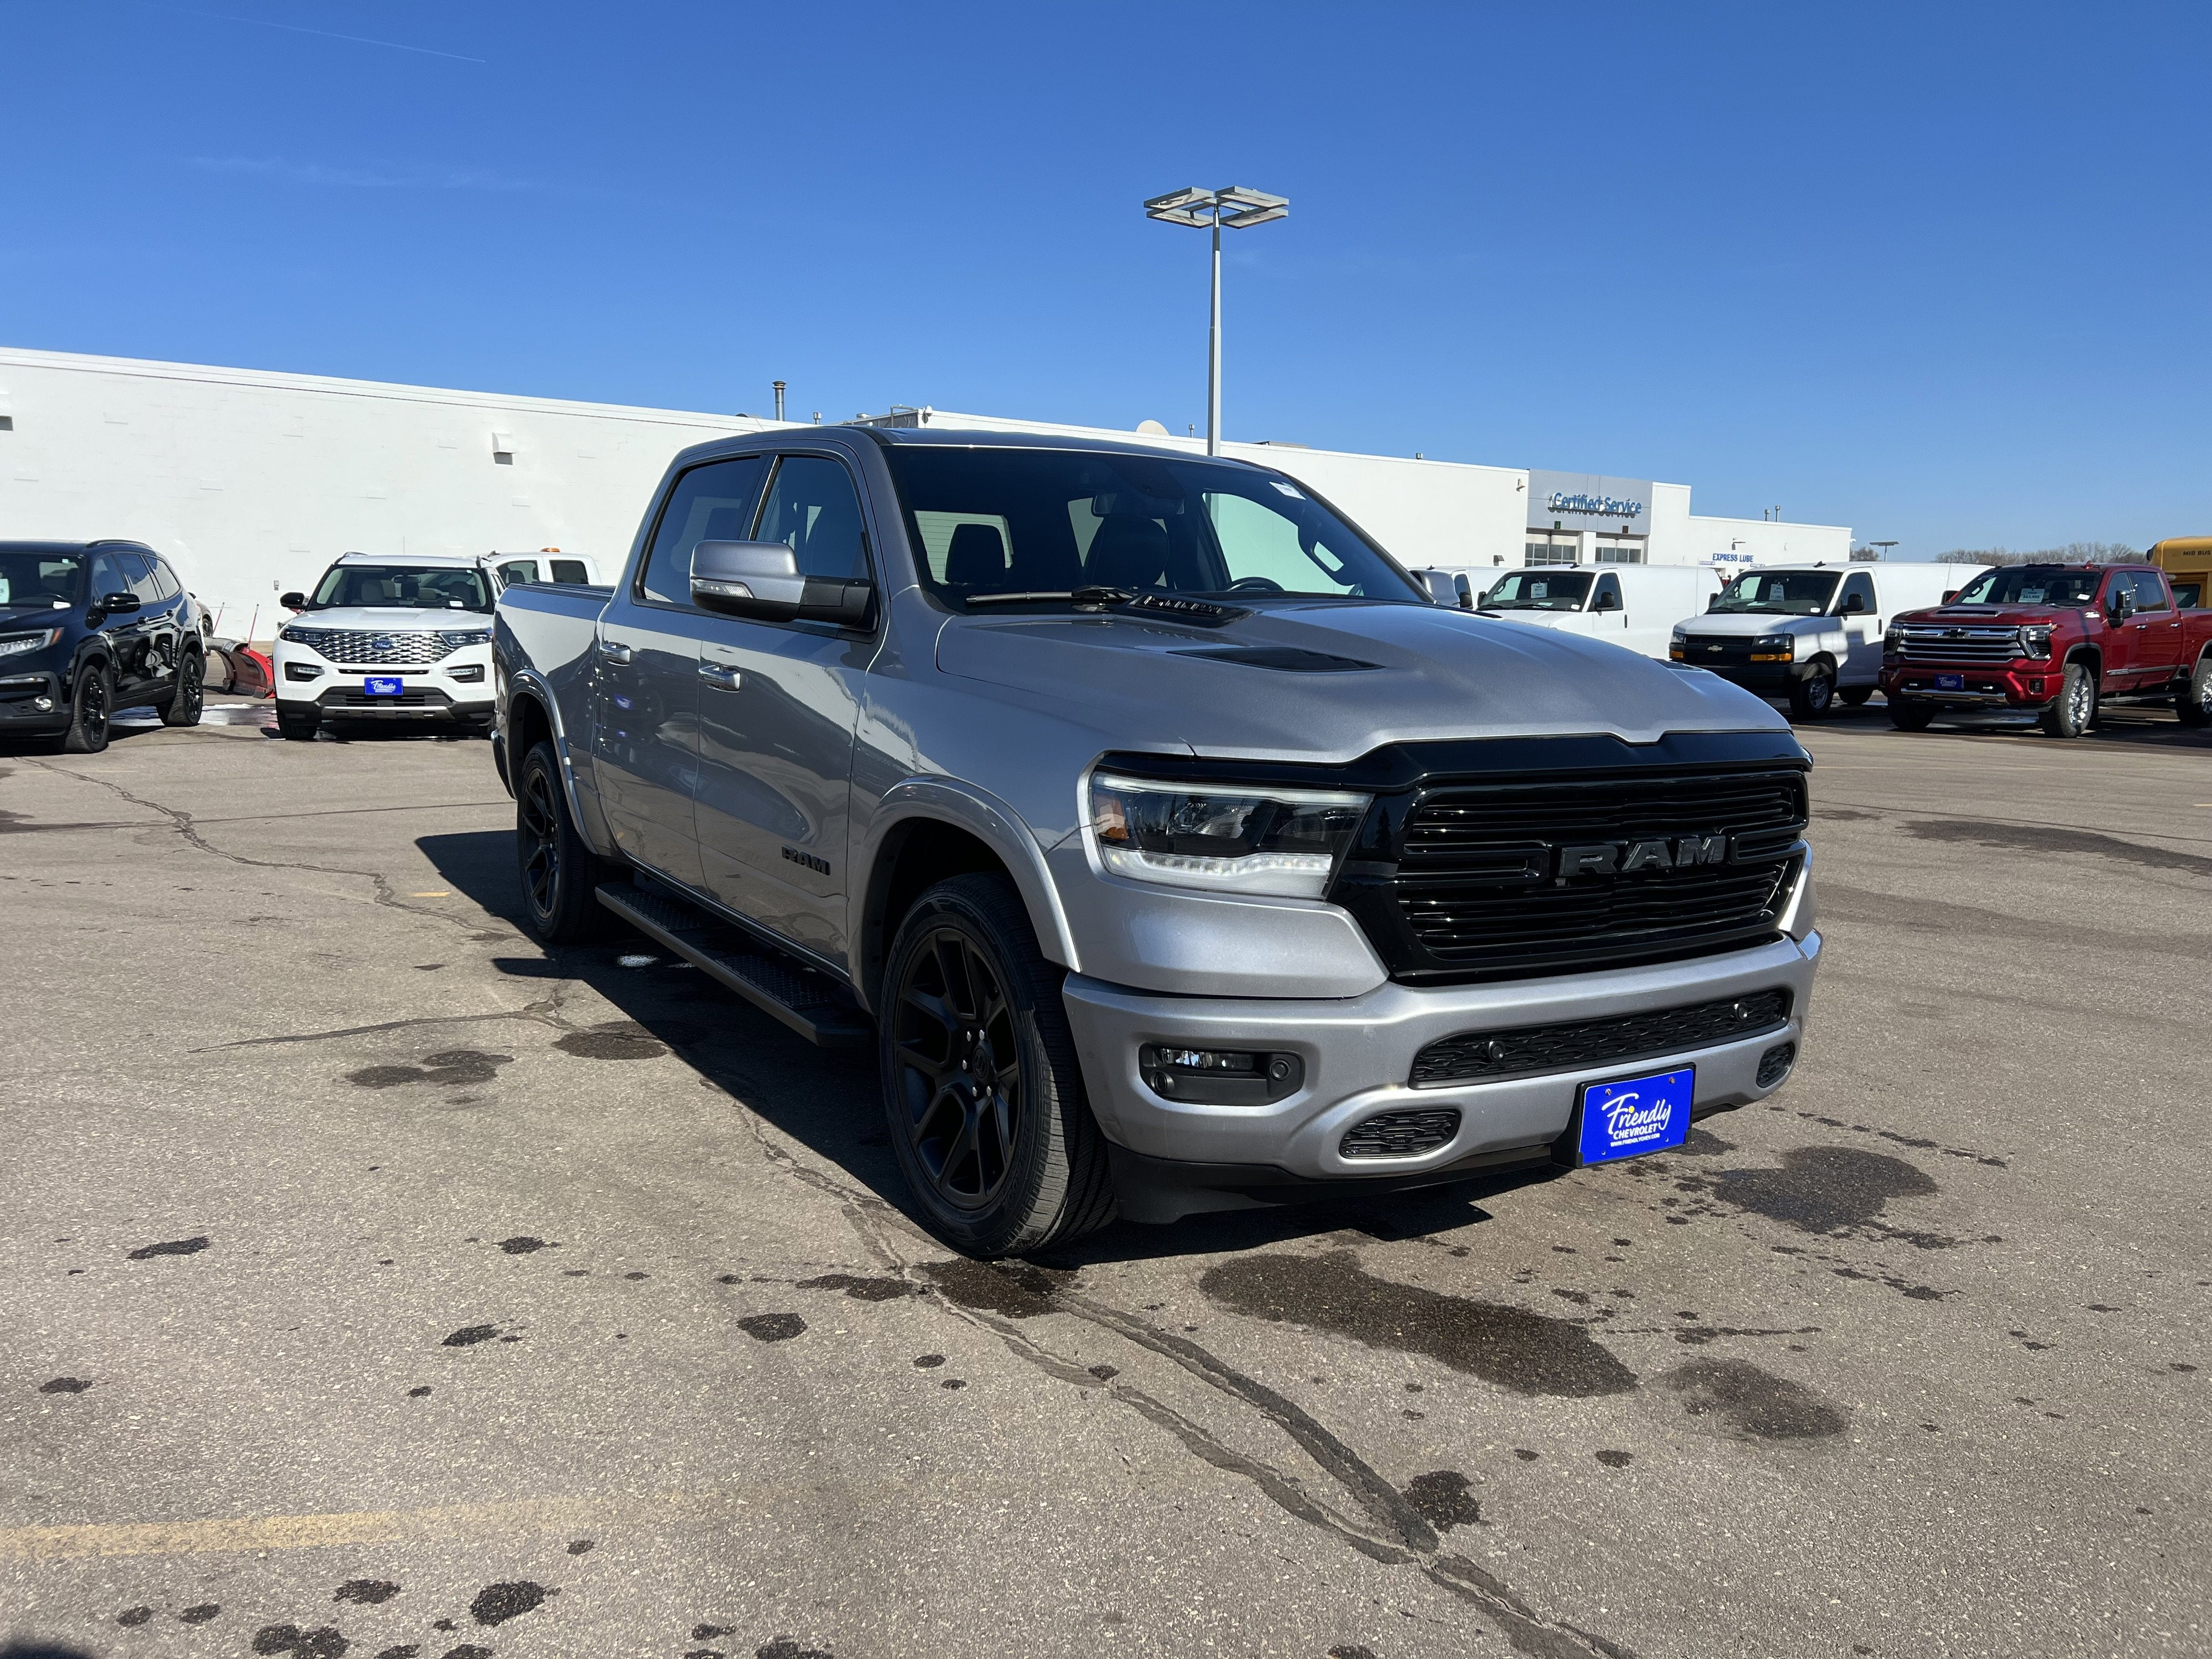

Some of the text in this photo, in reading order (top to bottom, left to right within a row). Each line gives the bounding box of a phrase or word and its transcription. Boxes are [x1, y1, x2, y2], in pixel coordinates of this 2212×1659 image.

[1551, 492, 1642, 514] Certified Service
[1712, 553, 1754, 563] EXPRESS LUBE
[370, 680, 396, 692] Friendly
[781, 845, 831, 876] RAM
[1559, 835, 1726, 876] RAM
[1601, 1093, 1672, 1135] Friendly
[1613, 1123, 1657, 1140] CHEVROLET
